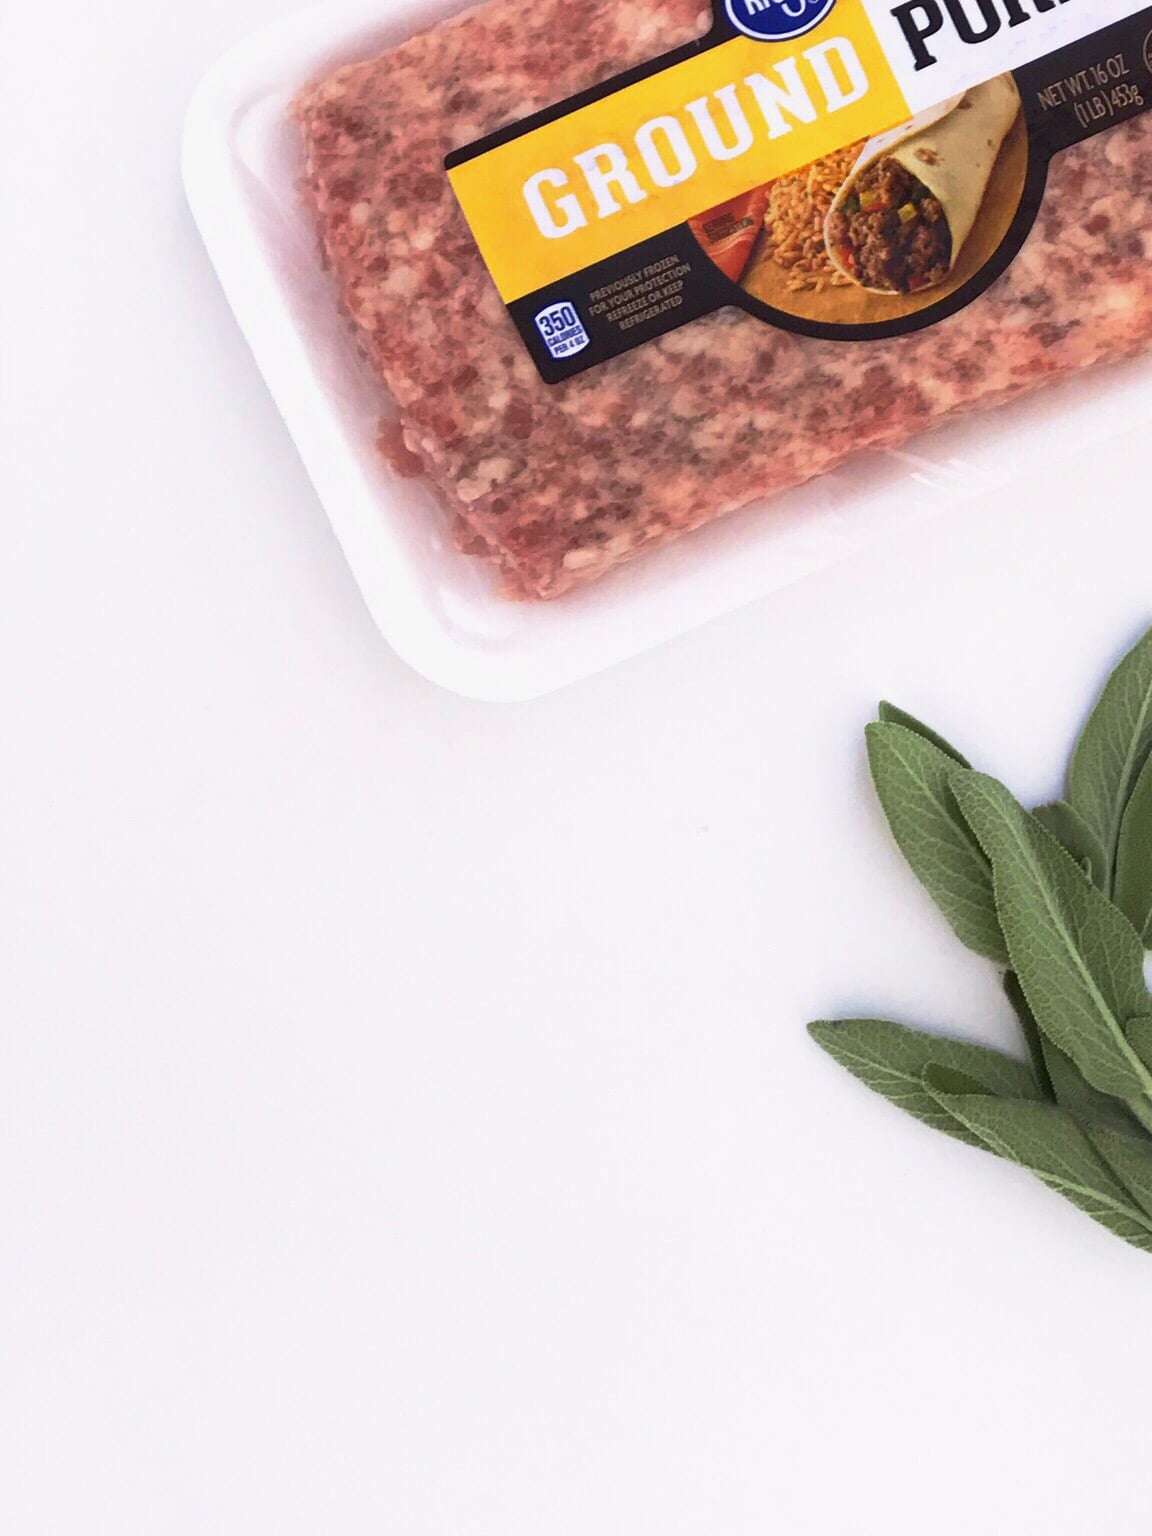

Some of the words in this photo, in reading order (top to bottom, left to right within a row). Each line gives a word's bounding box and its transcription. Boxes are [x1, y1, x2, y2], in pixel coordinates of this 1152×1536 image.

[1037, 82, 1066, 110] NET
[1064, 70, 1094, 96] WT.
[1090, 64, 1108, 85] 16
[1106, 54, 1130, 78] OZ
[1112, 84, 1143, 107] 453g
[523, 37, 868, 238] GROUND
[589, 302, 609, 316] FOR
[608, 290, 635, 307] YOUR
[634, 263, 691, 295] PROTECTION
[590, 271, 642, 301] PREVIOUSLY
[644, 255, 679, 277] FROZEN
[606, 297, 648, 321] REFREEZE
[648, 291, 663, 302] OR
[662, 280, 683, 296] KEEP
[619, 296, 682, 330] REFRIGERATED
[539, 306, 576, 336] 350
[548, 326, 582, 346] CALORIES
[554, 344, 568, 354] PER
